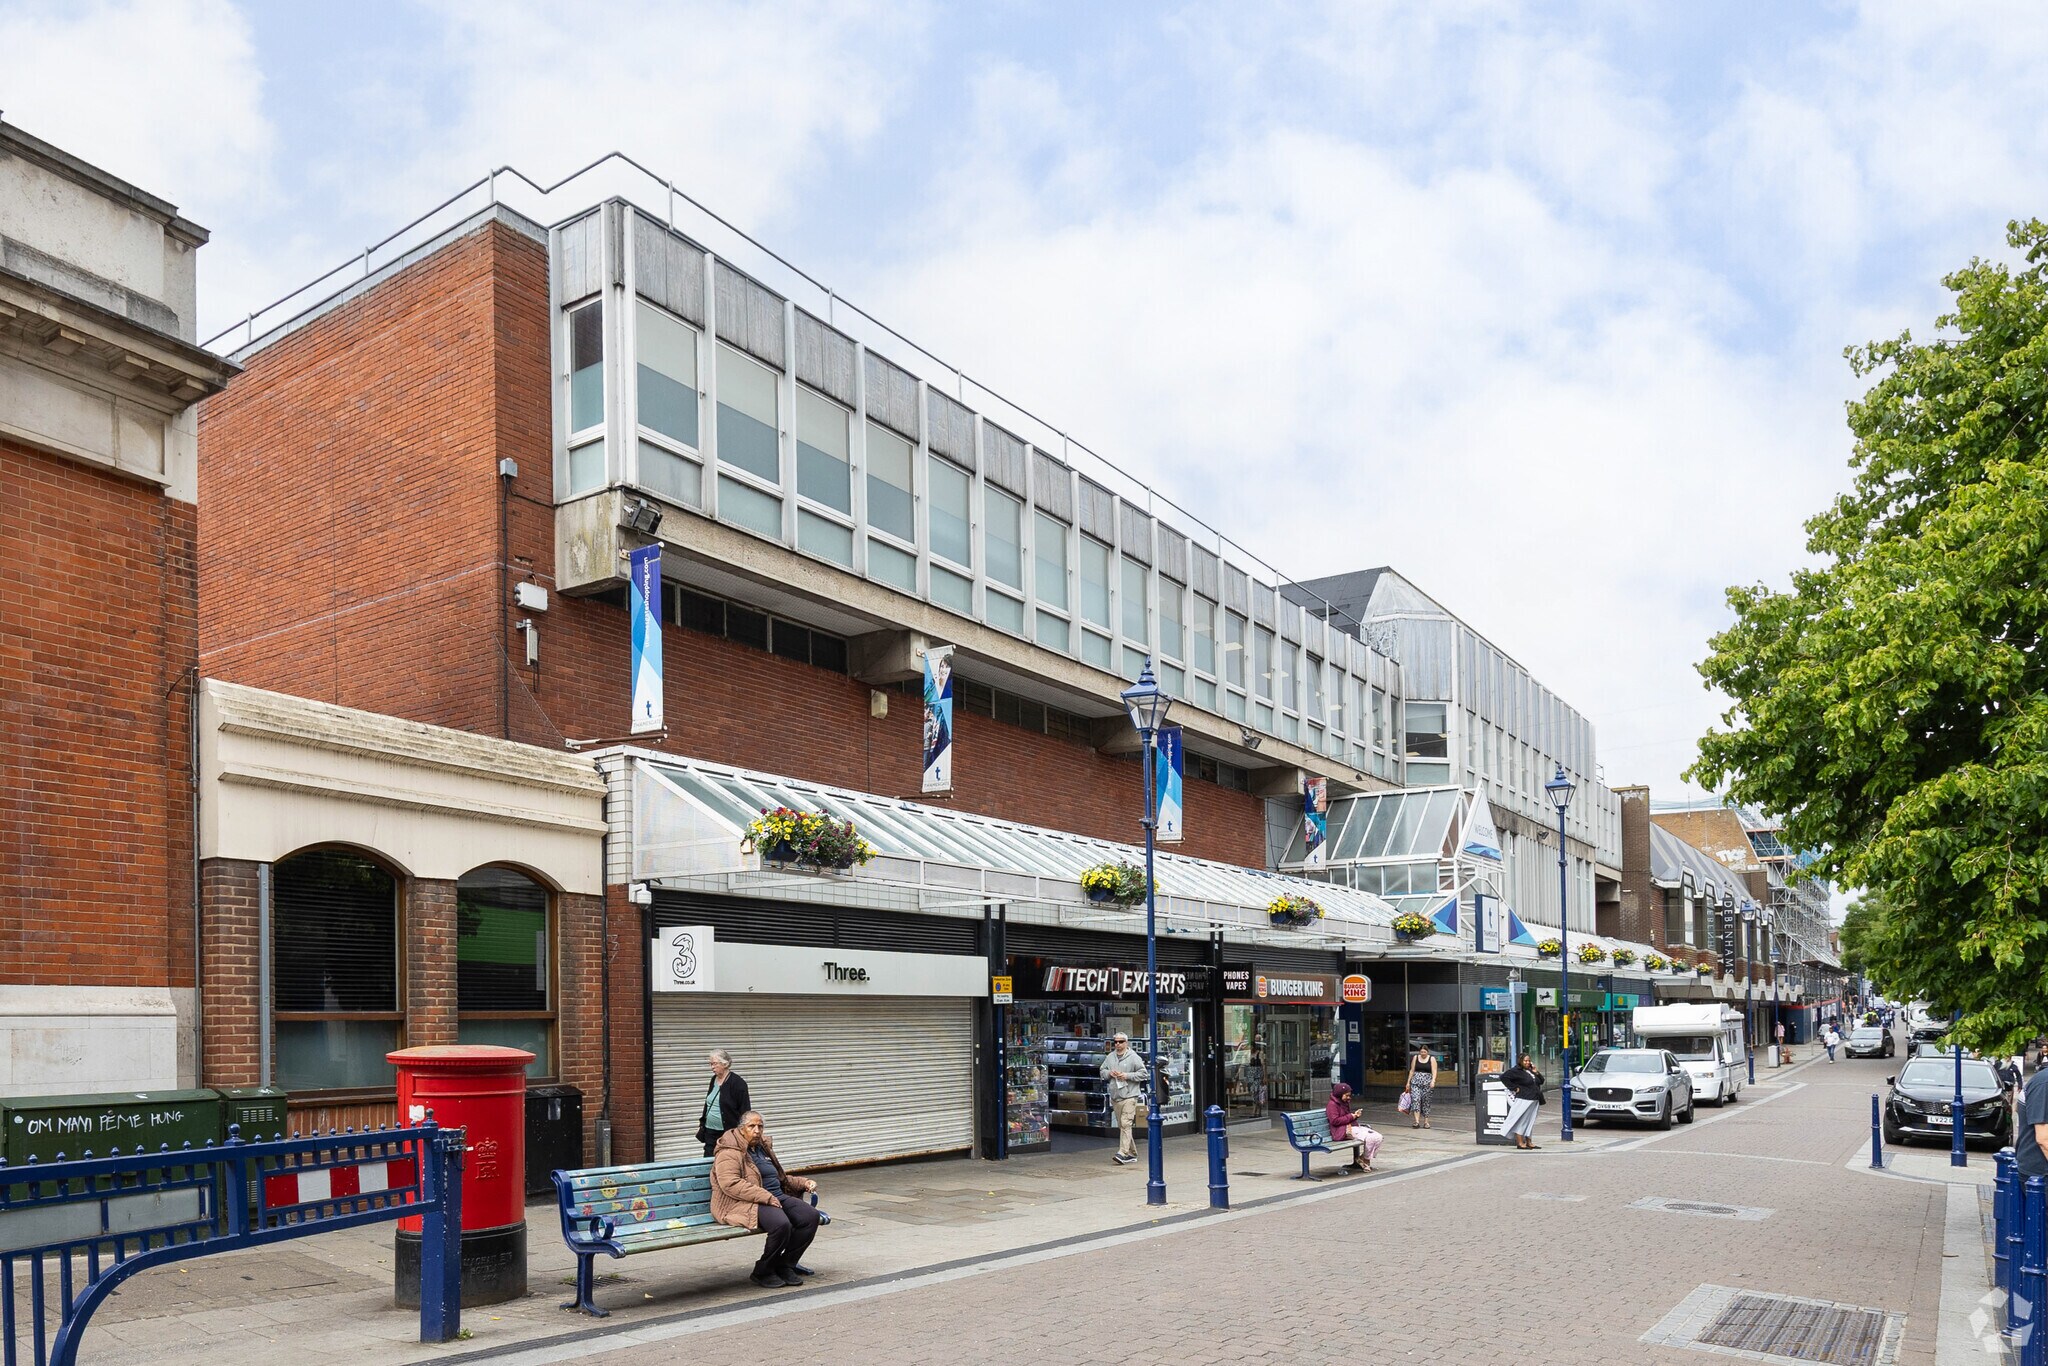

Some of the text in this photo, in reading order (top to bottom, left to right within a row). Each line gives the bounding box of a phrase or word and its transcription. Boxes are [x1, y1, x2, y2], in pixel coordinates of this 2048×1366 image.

[1723, 900, 1734, 975] DEBENHAMS
[823, 961, 871, 982] Three.
[1066, 967, 1187, 995] TECH EXPERTS
[1223, 971, 1250, 980] PHONES
[1226, 981, 1247, 990] VAPES
[1270, 979, 1324, 997] BURGER KING
[1344, 989, 1367, 997] KING
[28, 1118, 52, 1135] OM
[151, 1111, 184, 1127] HUNG
